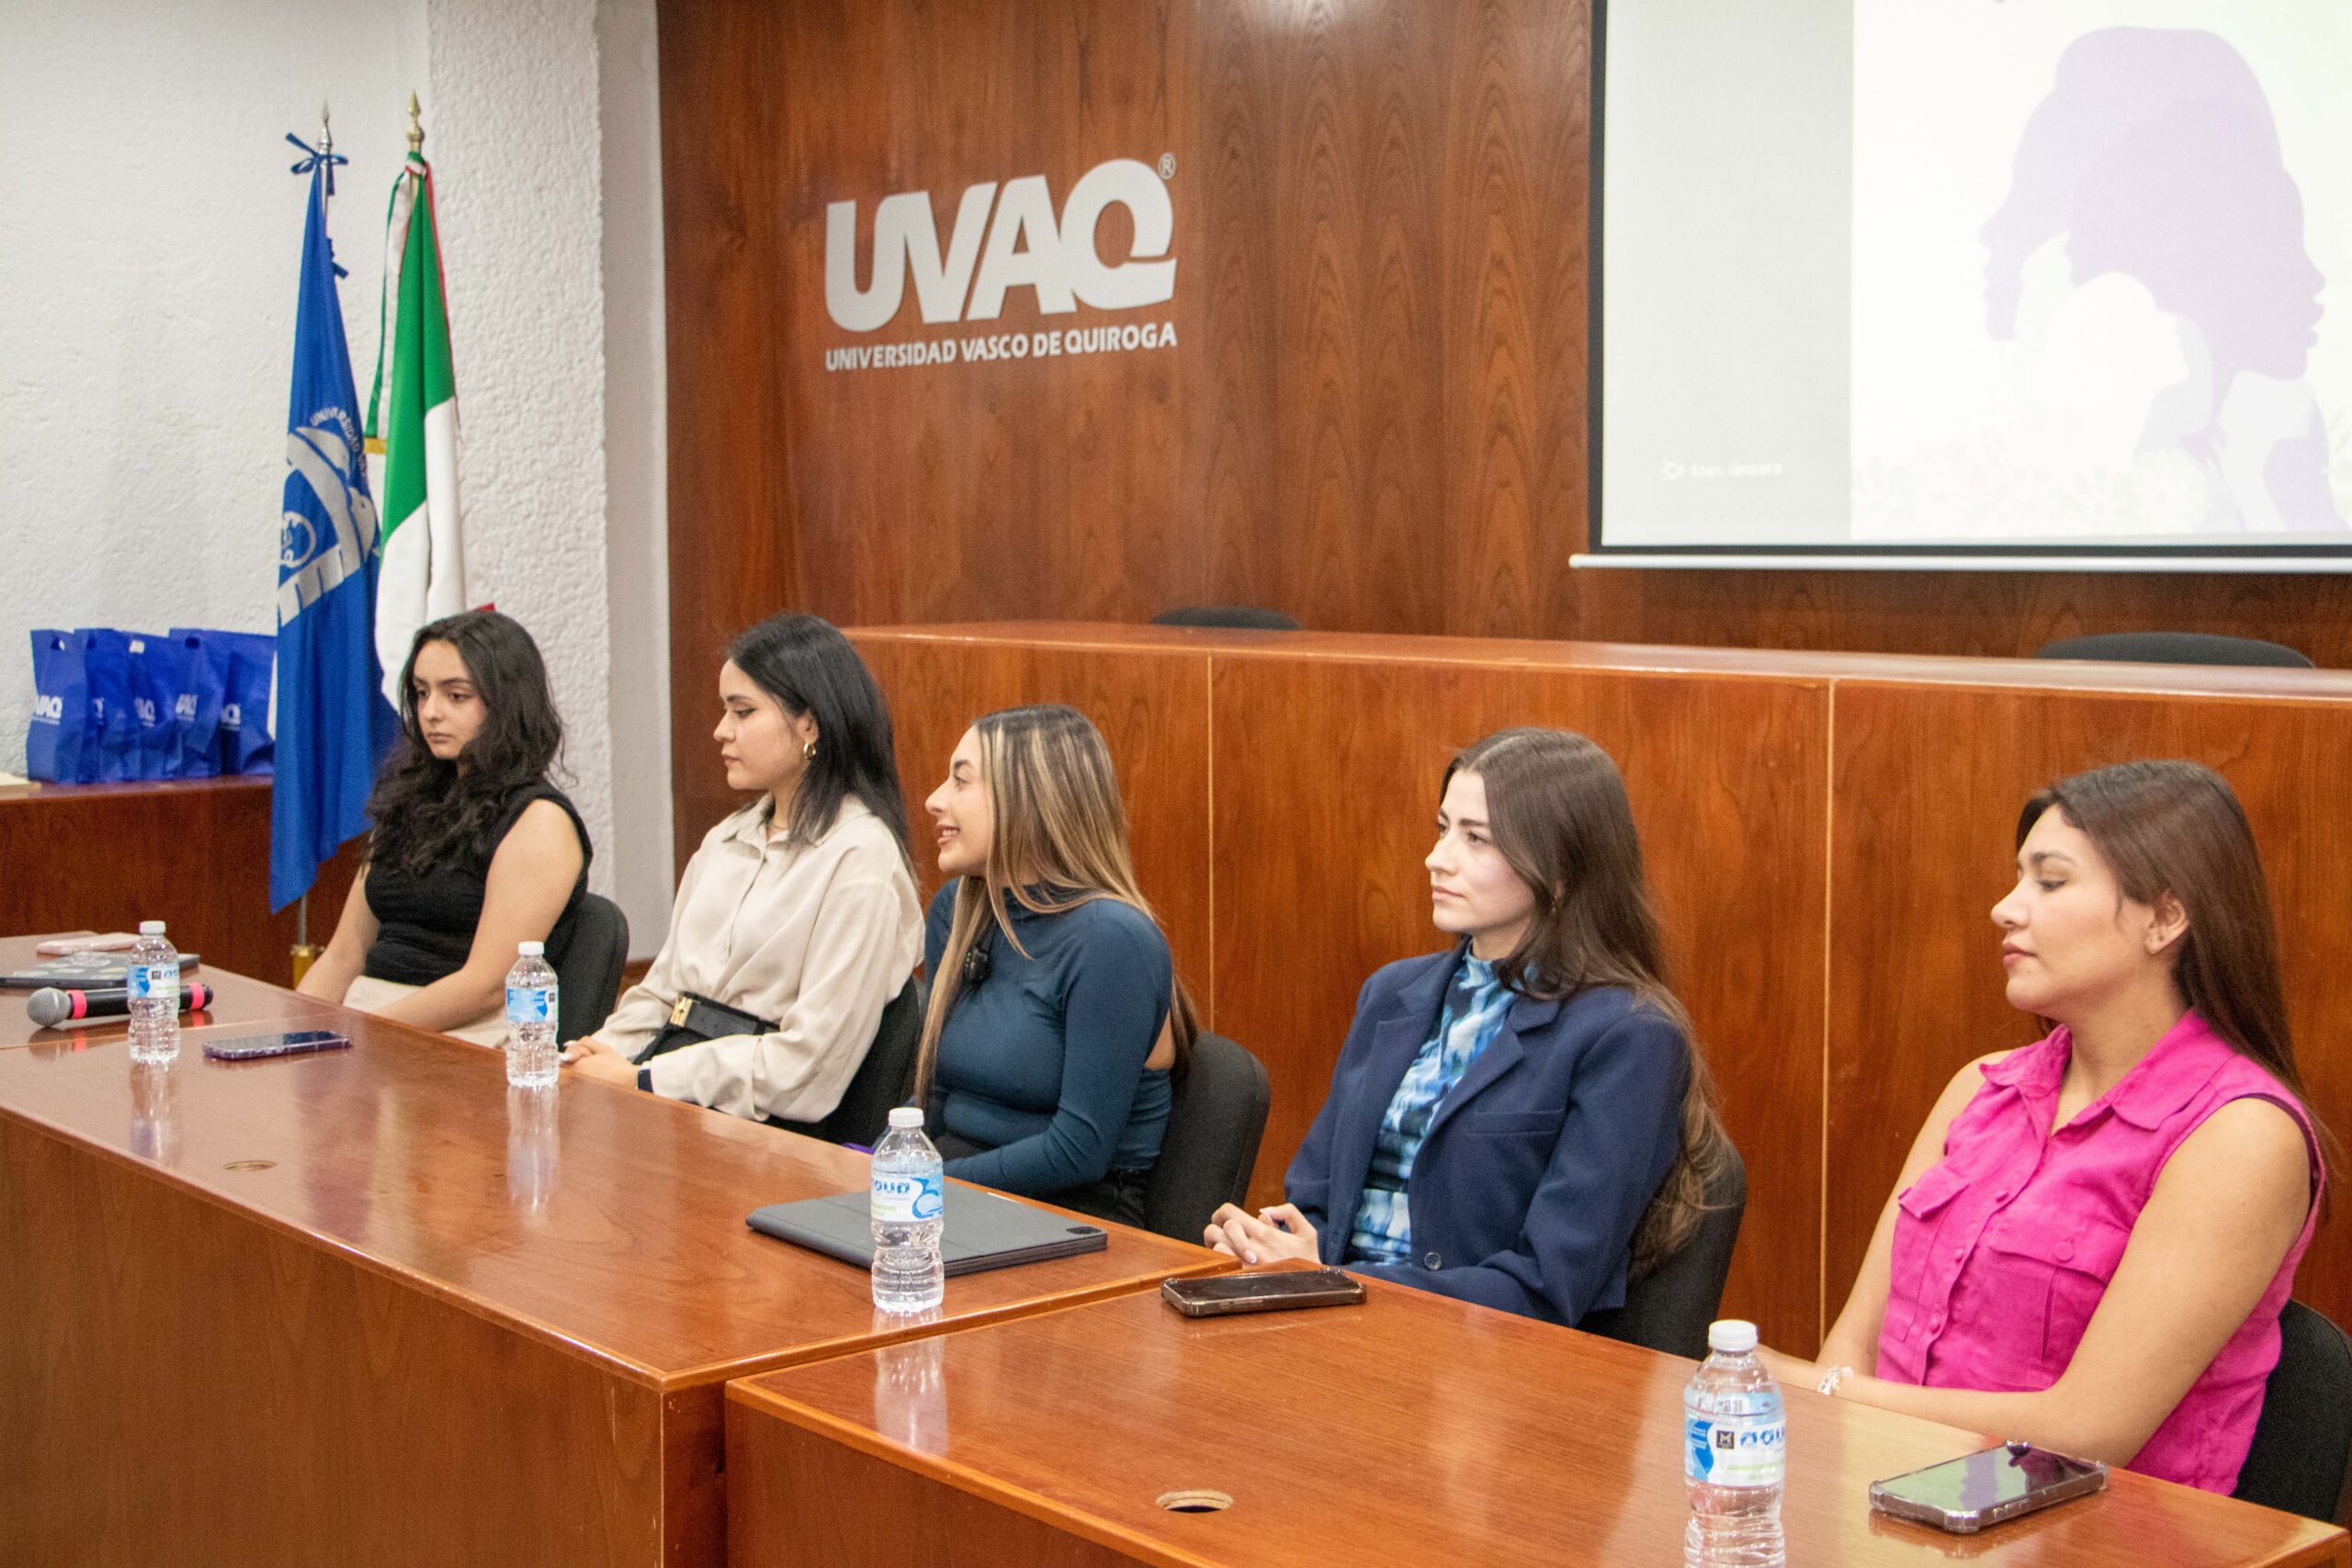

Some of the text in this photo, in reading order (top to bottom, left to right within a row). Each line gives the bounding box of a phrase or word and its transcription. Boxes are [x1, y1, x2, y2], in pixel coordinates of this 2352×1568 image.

[826, 158, 1177, 332] UVAQ
[826, 321, 1178, 371] UNIVERSIDAD VASCO DE QUIROGA
